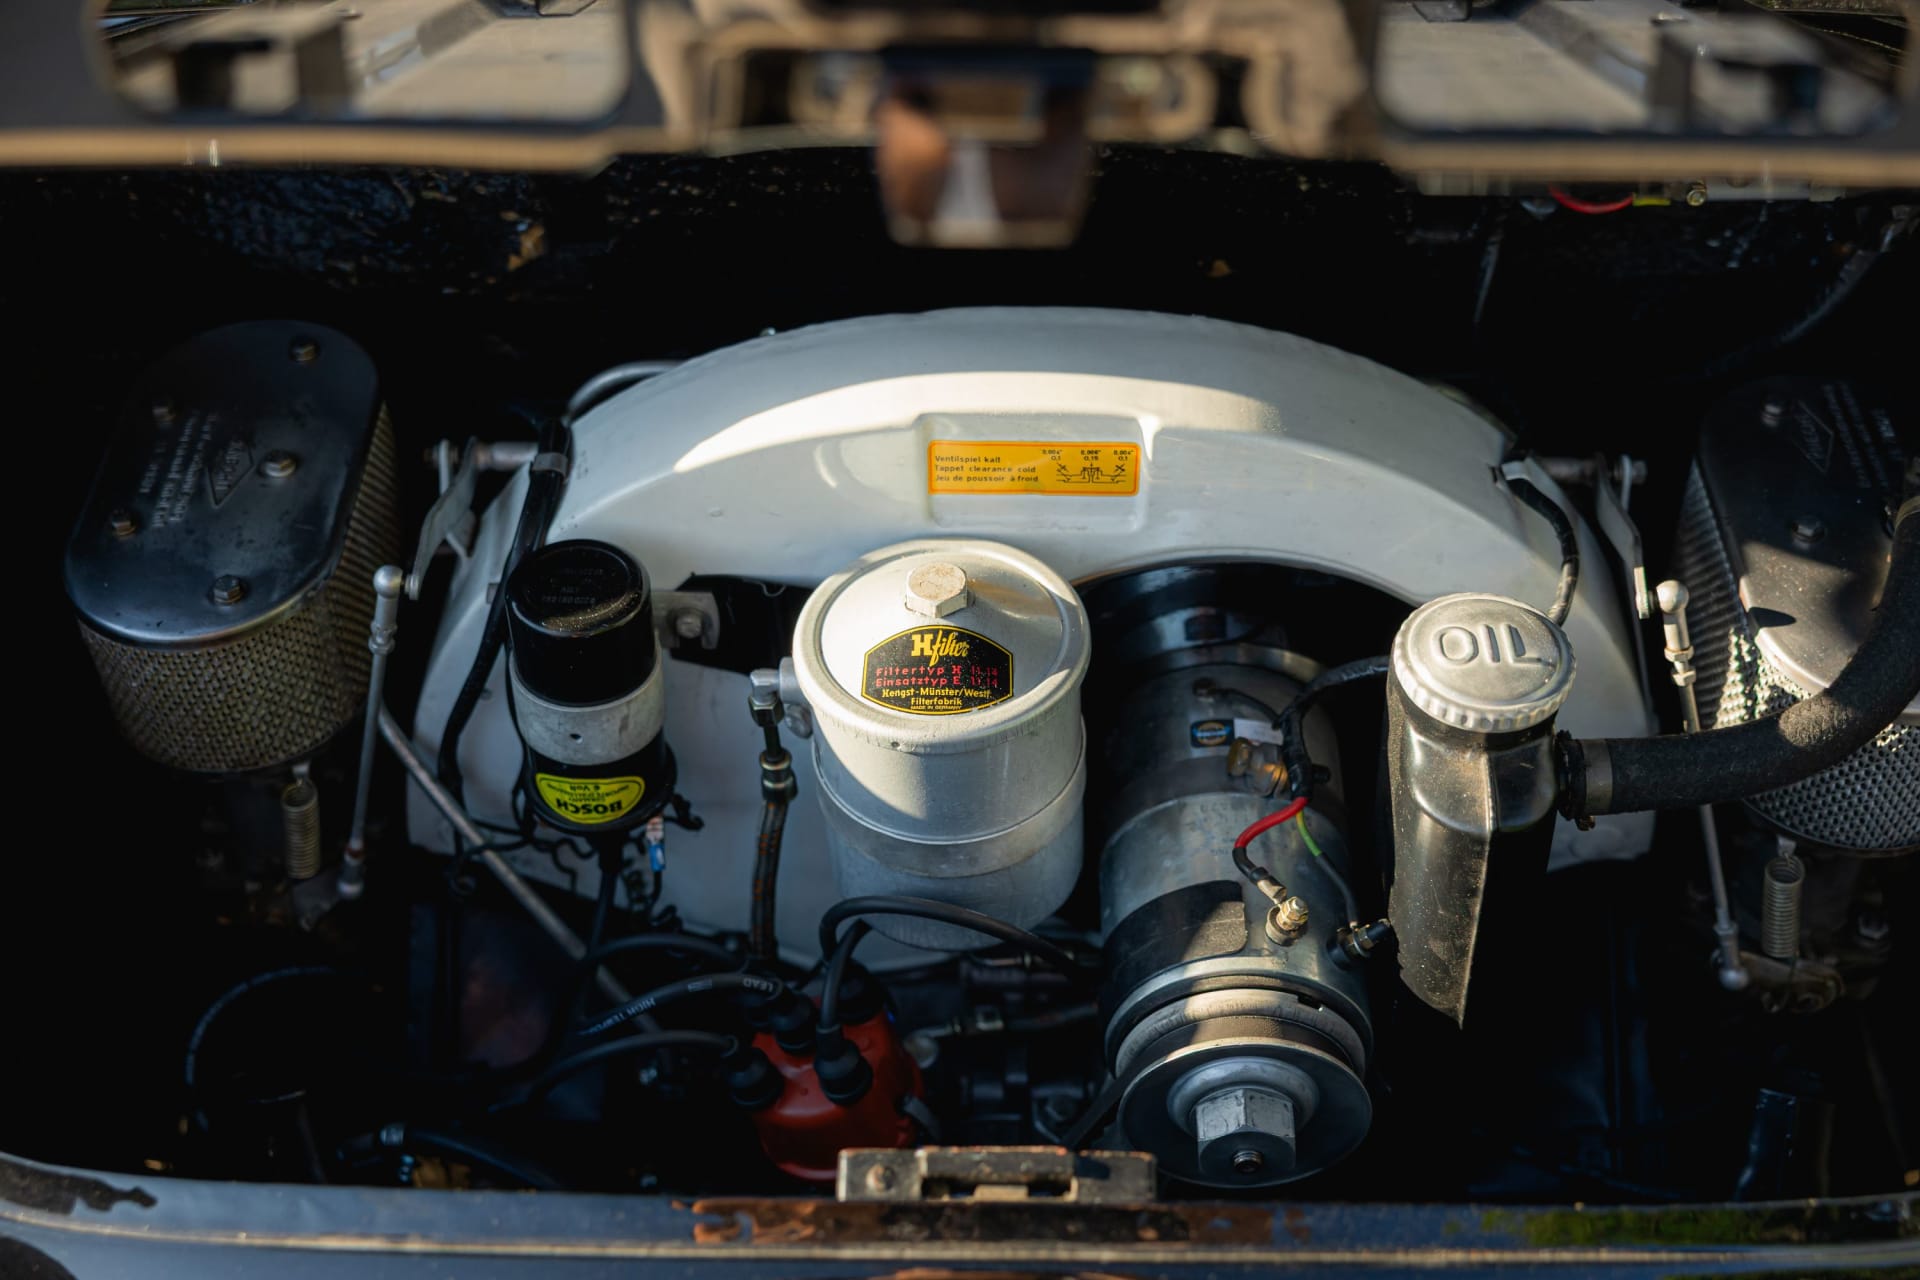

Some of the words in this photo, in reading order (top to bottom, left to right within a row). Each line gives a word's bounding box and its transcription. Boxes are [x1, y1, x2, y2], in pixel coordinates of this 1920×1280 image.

[935, 455, 981, 464] Ventilspiel
[935, 464, 964, 472] Tappet
[969, 465, 1013, 473] clearance
[1432, 624, 1543, 665] OIL
[875, 665, 945, 676] Filtertyp
[875, 676, 948, 688] Einsatztyp
[953, 676, 961, 685] E
[556, 798, 622, 814] BOSCH
[742, 977, 775, 993] LEAD
[626, 997, 657, 1018] HIGH
